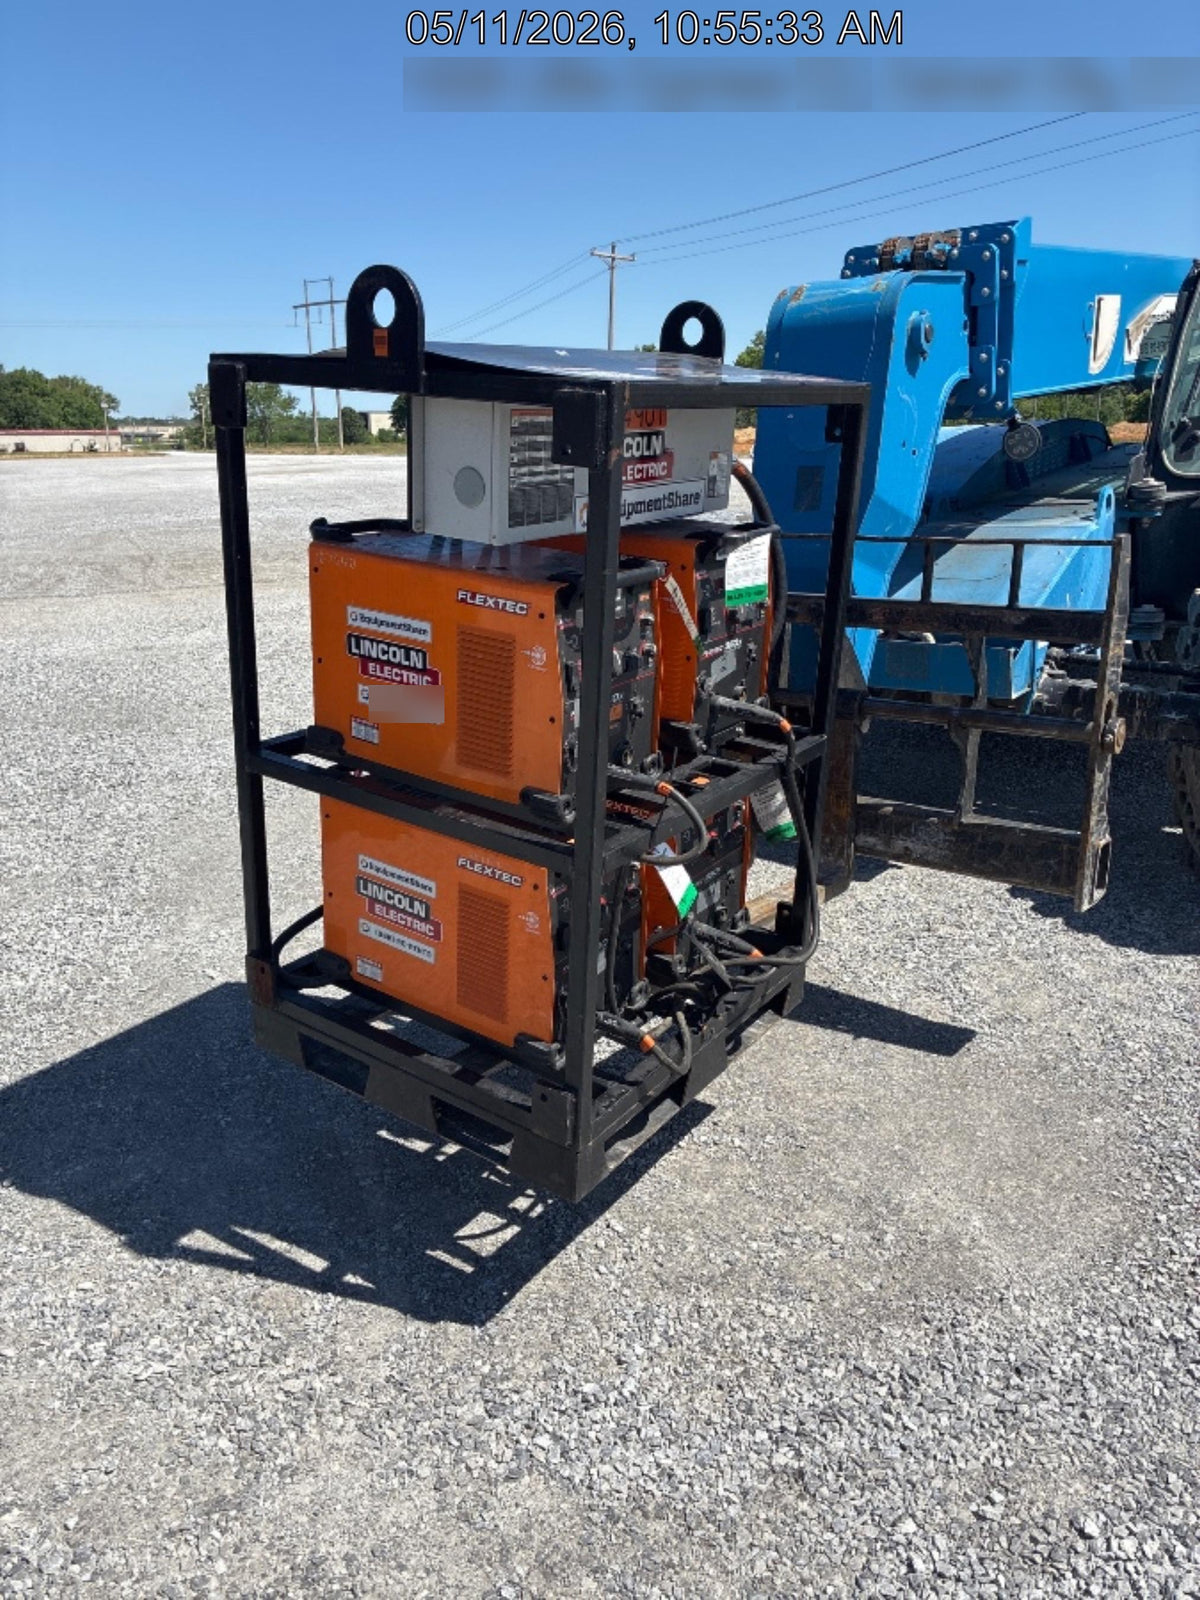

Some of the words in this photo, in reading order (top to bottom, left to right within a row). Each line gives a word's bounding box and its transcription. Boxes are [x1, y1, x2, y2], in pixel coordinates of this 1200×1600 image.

[624, 435, 663, 458] COLN
[622, 462, 668, 481] ECTRIC
[621, 491, 701, 519] ipmentShare
[457, 591, 529, 614] FLEXTEC
[350, 636, 425, 669] LINCOLN
[368, 662, 433, 685] ELECTRIC
[457, 858, 523, 886] FLEXTEC
[360, 879, 427, 918] LINCOLN
[375, 904, 435, 936] ELECTRIC
